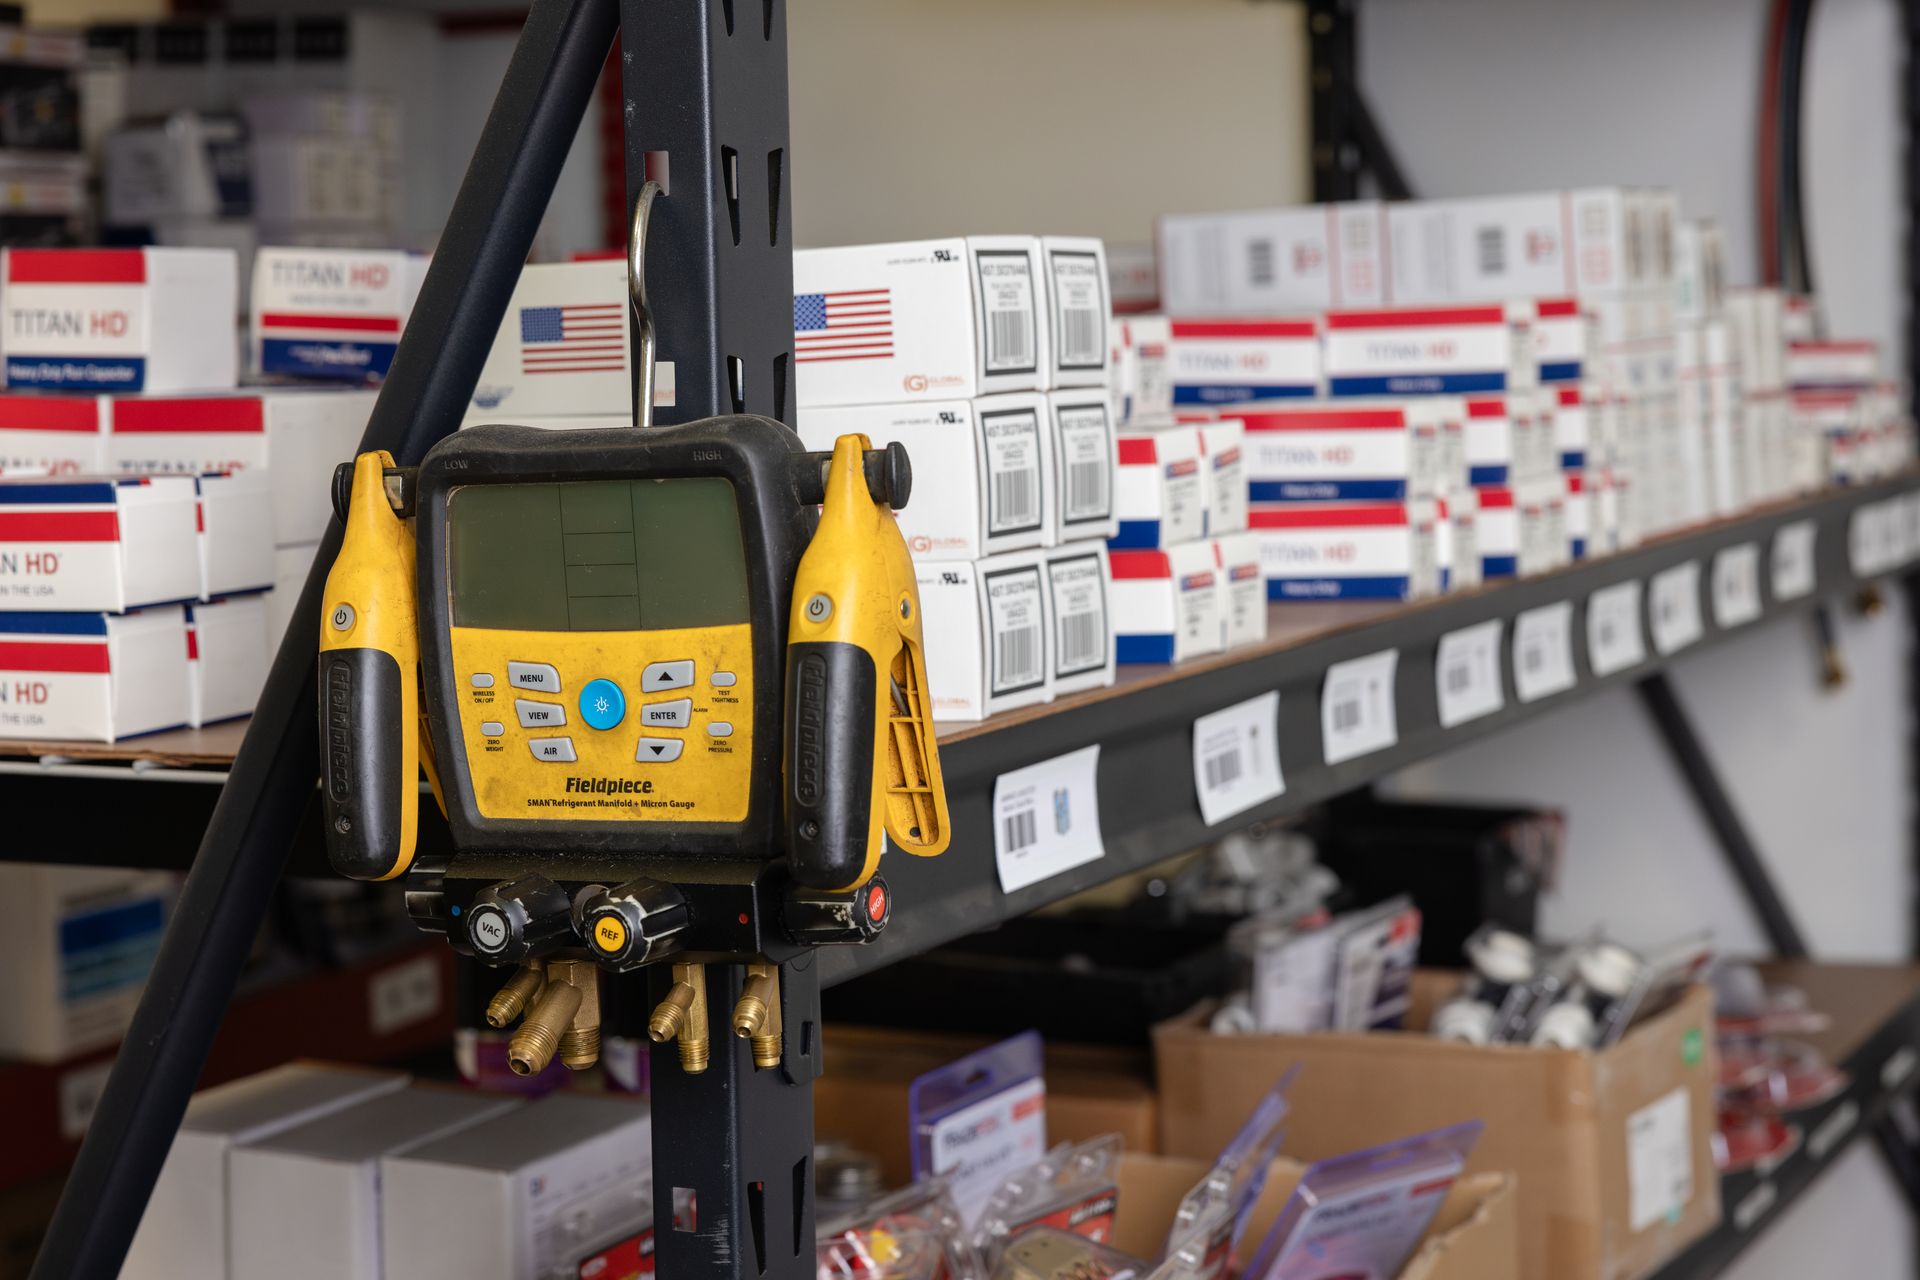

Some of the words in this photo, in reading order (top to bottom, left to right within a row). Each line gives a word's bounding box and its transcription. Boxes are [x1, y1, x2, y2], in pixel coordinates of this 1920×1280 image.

[272, 261, 345, 288] TITAN
[350, 263, 390, 290] HD
[12, 309, 82, 337] TITAN
[89, 309, 130, 337] HD
[693, 450, 722, 461] HIGH
[444, 459, 468, 470] LOW
[25, 552, 59, 576] HD
[519, 674, 544, 683] MENU
[15, 681, 49, 705] HD
[528, 711, 549, 720] VIEW
[650, 711, 677, 720] ENTER
[543, 747, 558, 755] AIR
[565, 777, 653, 796] Fieldpiece
[552, 799, 596, 809] Refrigerant
[597, 799, 633, 808] Manifold
[640, 799, 668, 808] Micron
[669, 799, 695, 810] Gauge
[870, 892, 884, 916] HIGH
[482, 921, 501, 938] VAC
[601, 927, 620, 942] REF
